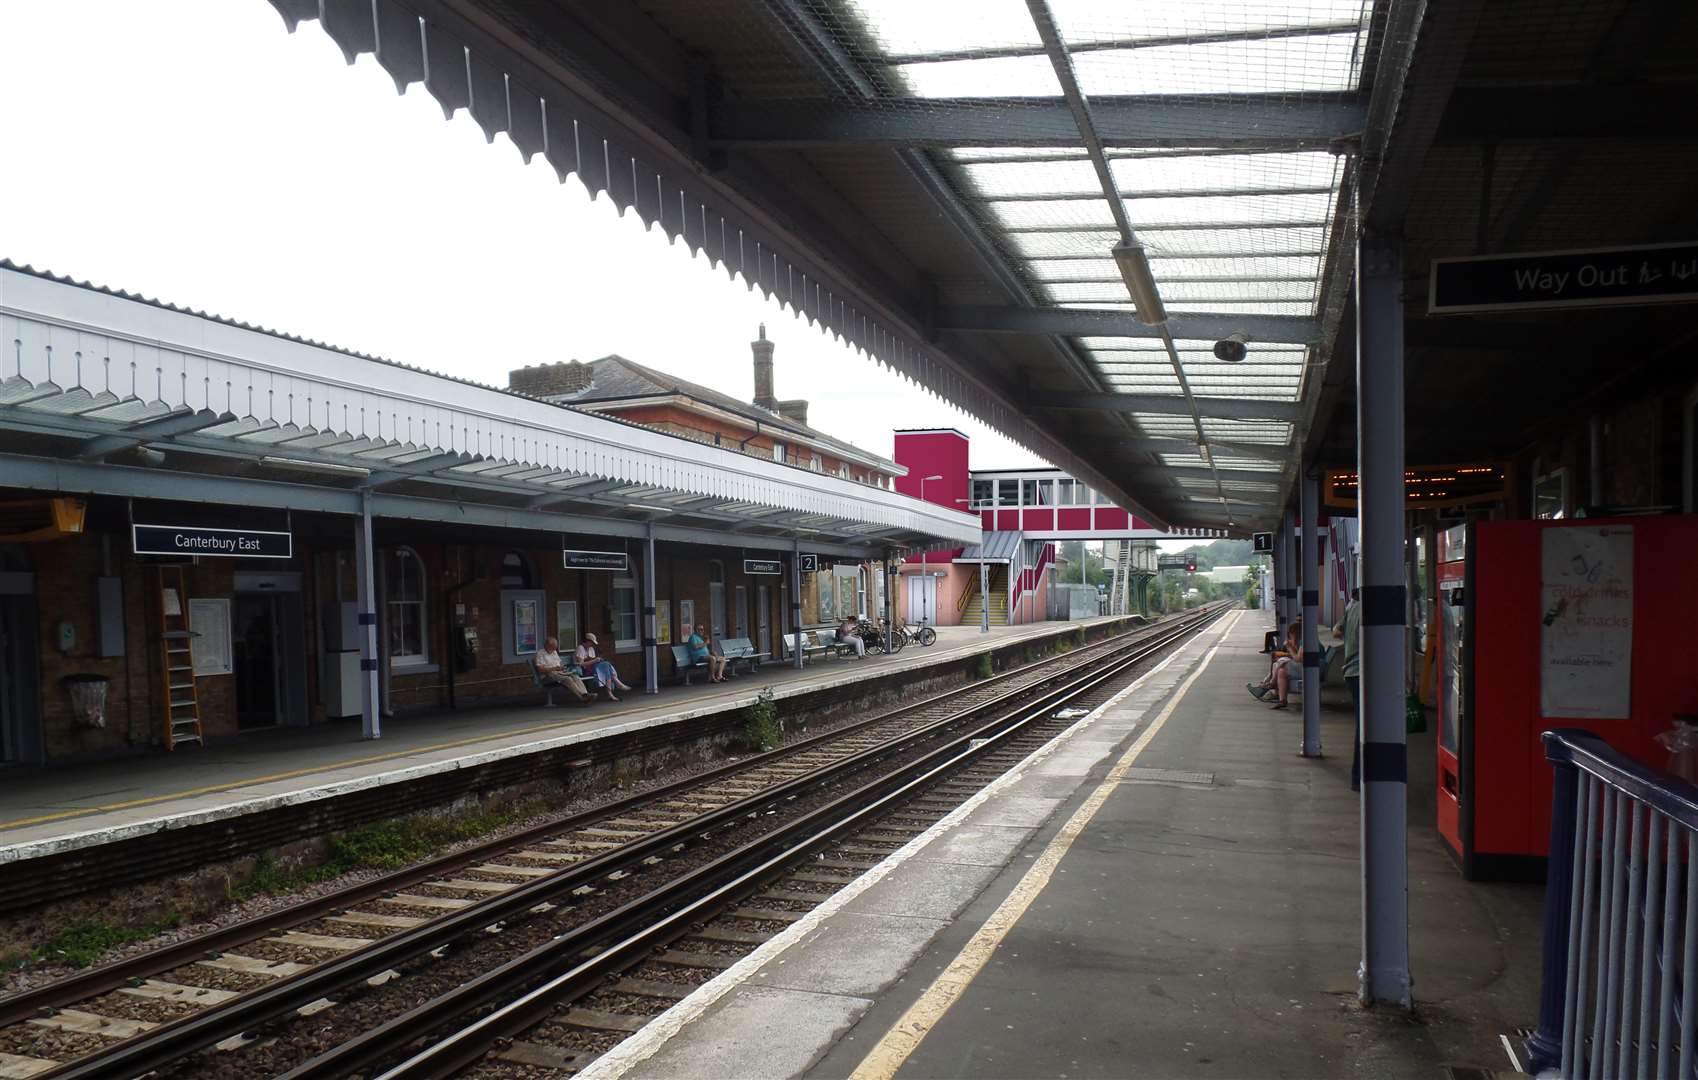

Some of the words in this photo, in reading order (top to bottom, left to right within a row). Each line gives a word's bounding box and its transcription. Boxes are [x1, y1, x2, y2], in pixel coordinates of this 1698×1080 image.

[1514, 267, 1570, 294] Way
[1577, 263, 1631, 287] Out
[174, 533, 236, 552] Canterbury
[238, 537, 261, 550] East
[1258, 535, 1265, 548] 1
[804, 557, 812, 569] 2
[1549, 655, 1590, 666] available
[1591, 655, 1615, 667] here
